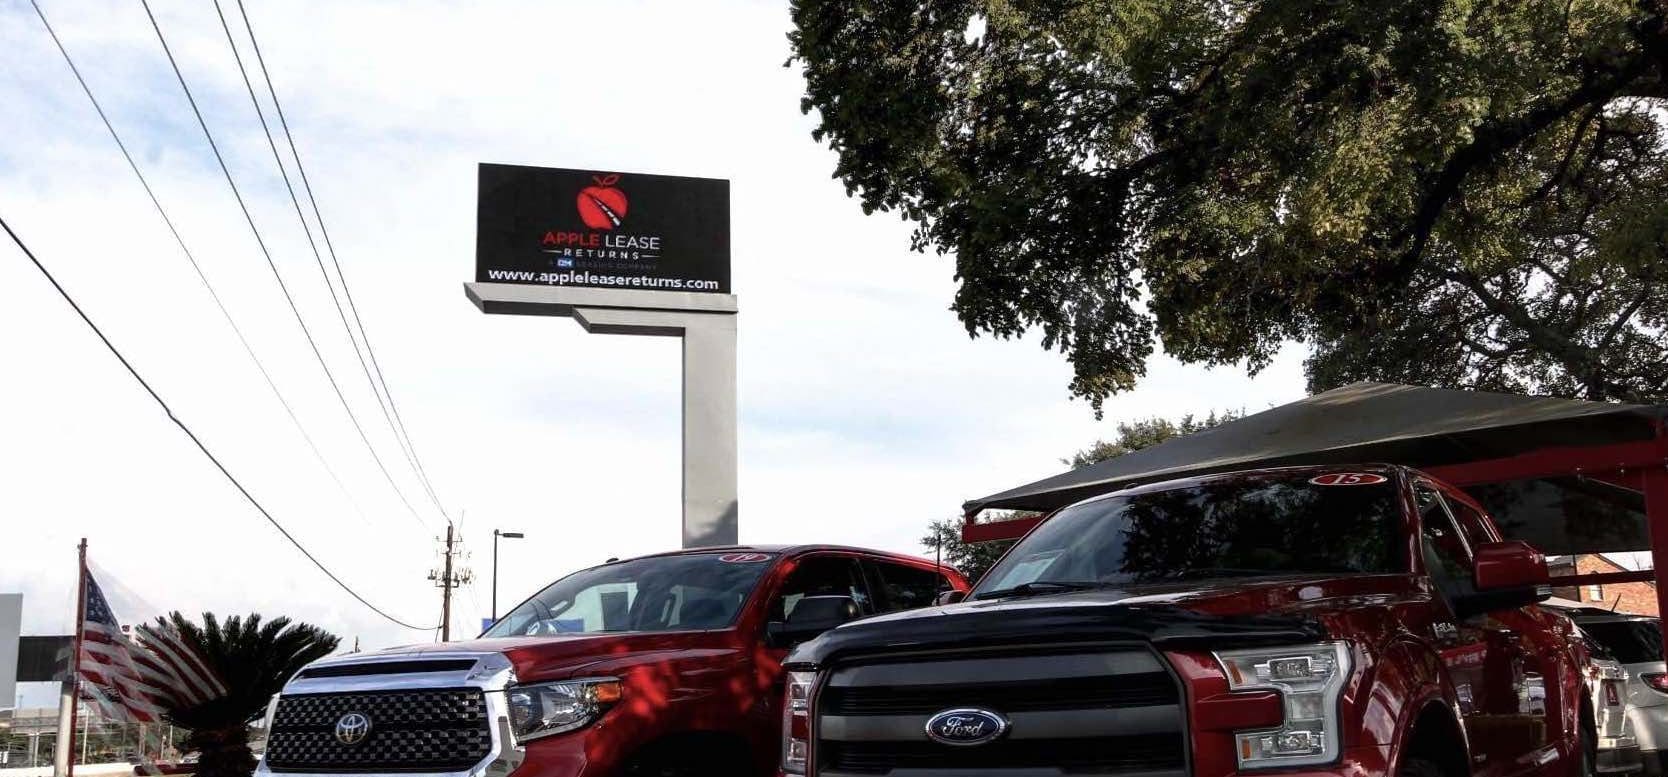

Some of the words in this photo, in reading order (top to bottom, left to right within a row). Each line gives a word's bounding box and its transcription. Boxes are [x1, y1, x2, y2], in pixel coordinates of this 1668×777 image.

[543, 231, 600, 248] APPLE
[605, 234, 661, 250] LEASE
[563, 248, 640, 260] RETURNS
[488, 269, 719, 290] www.appleleasereturns.com
[1331, 473, 1365, 485] 15
[942, 715, 985, 737] Ford
